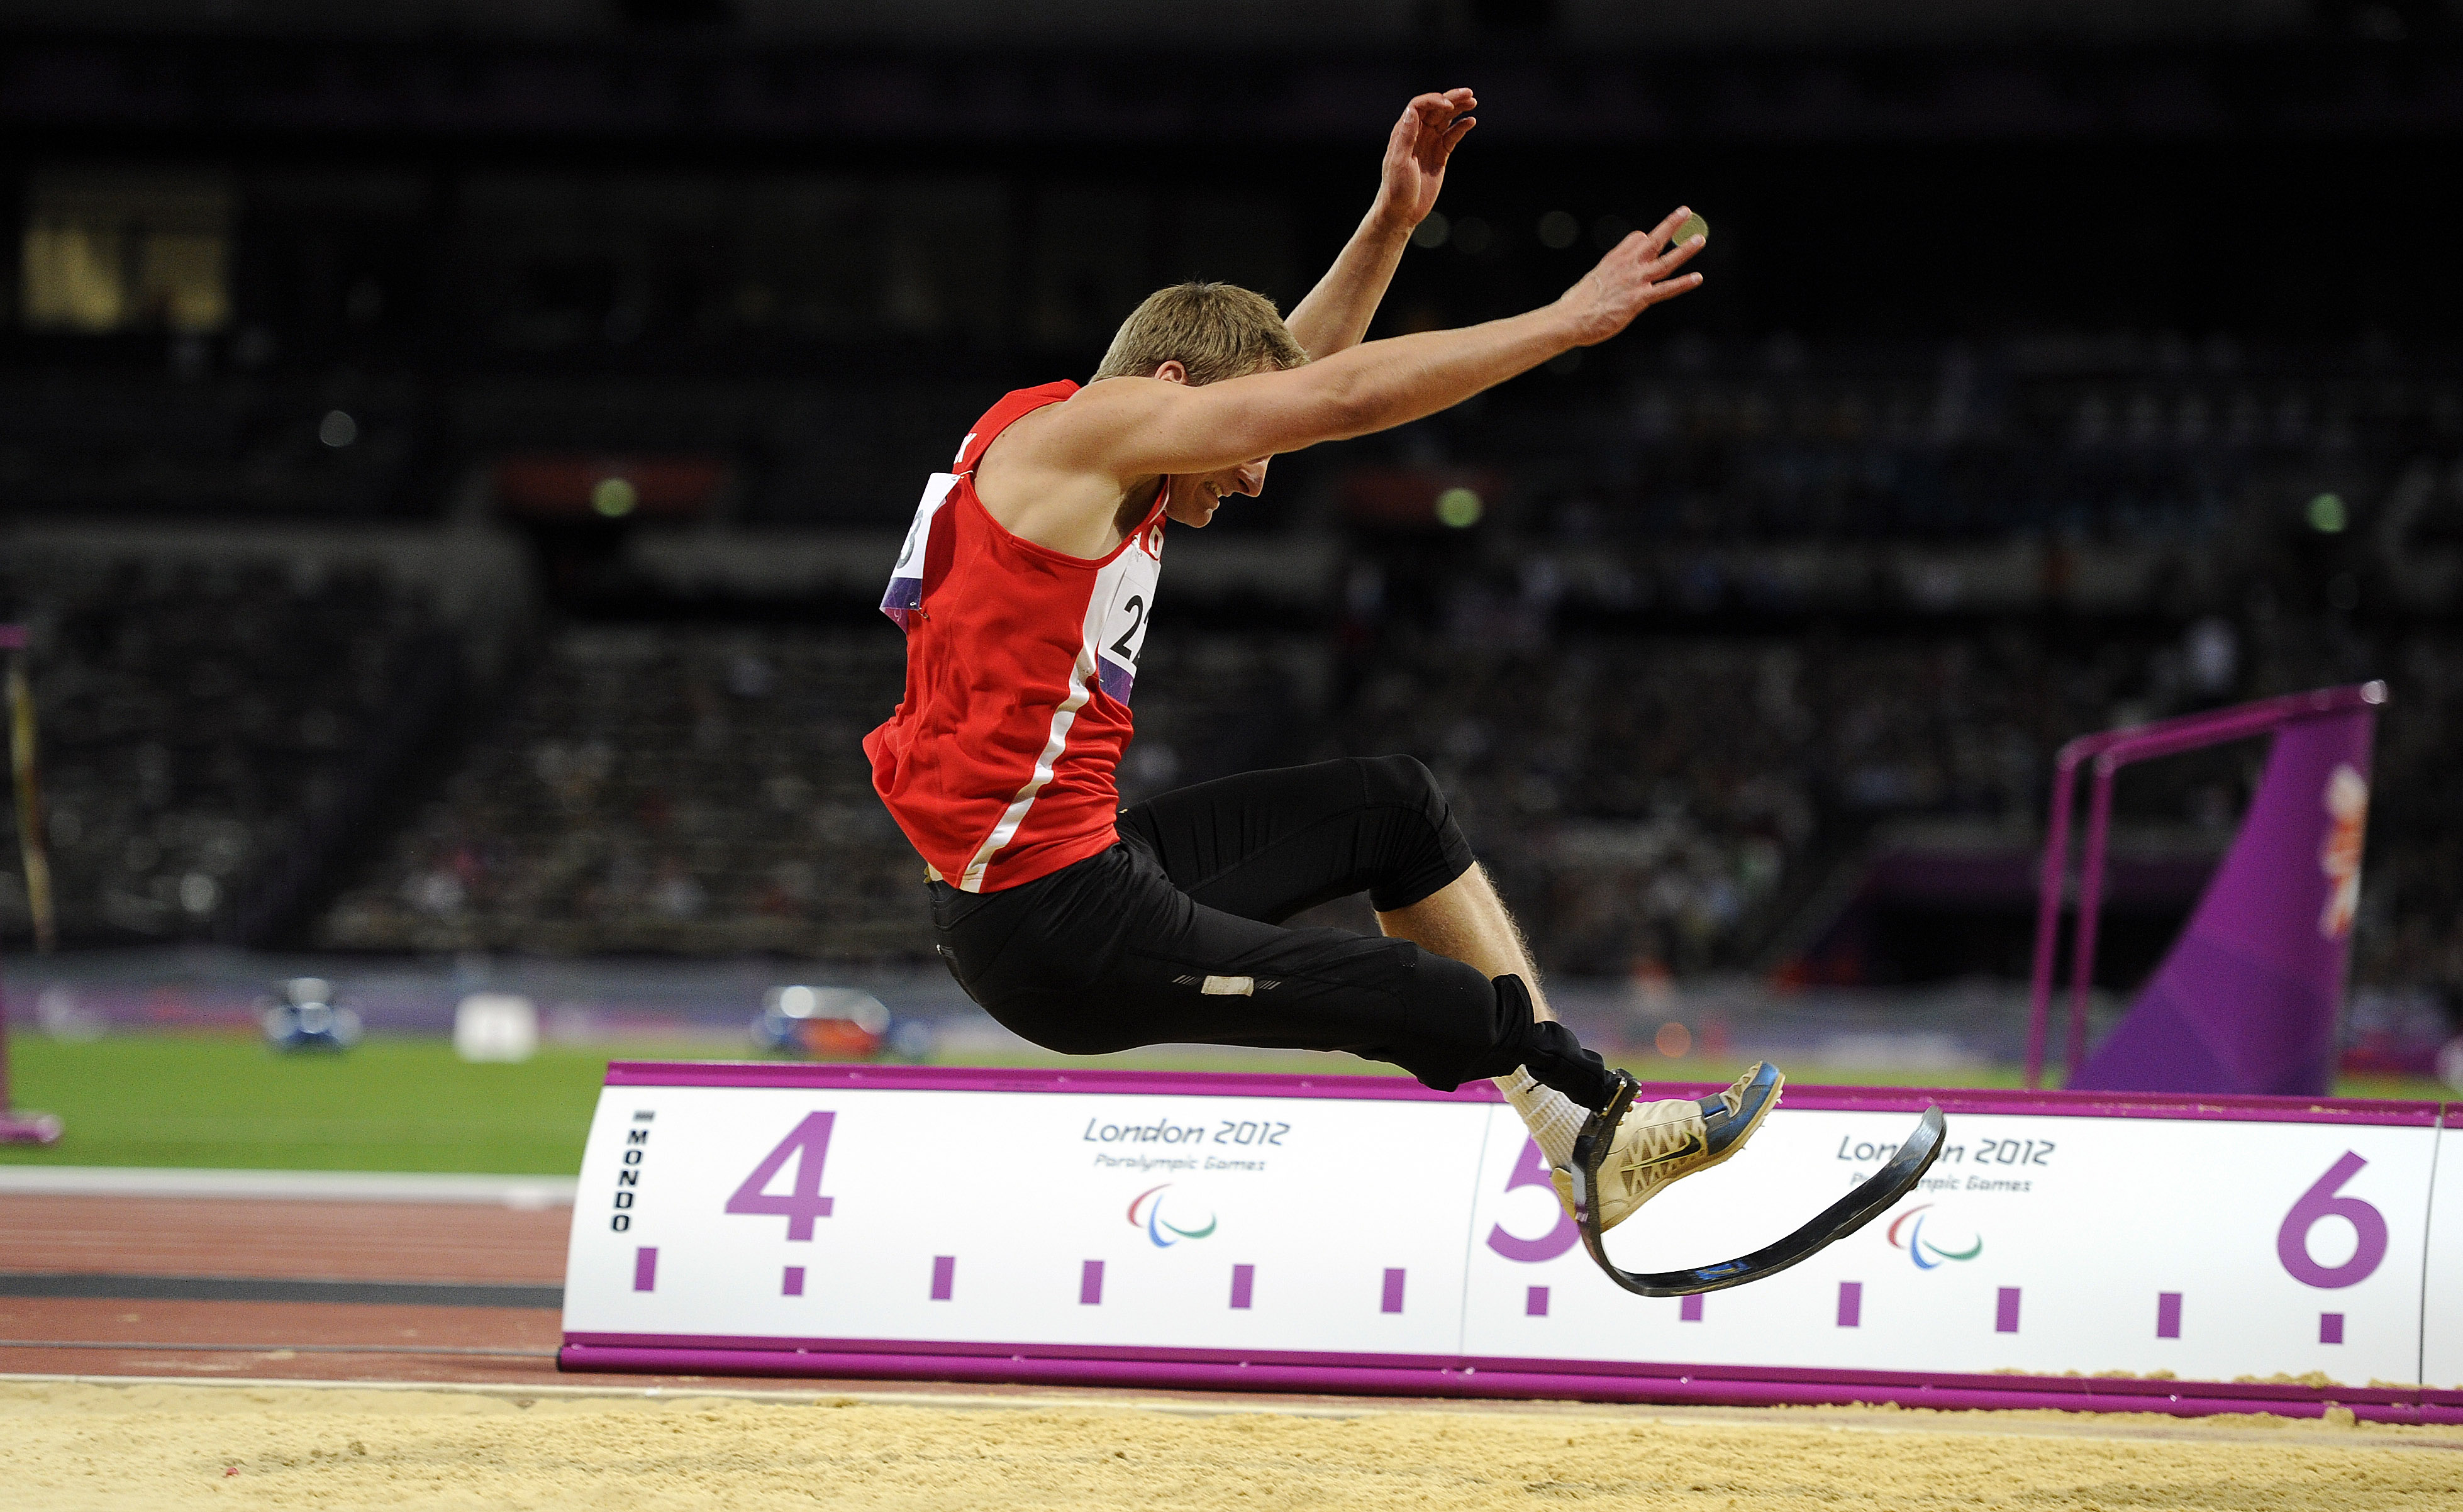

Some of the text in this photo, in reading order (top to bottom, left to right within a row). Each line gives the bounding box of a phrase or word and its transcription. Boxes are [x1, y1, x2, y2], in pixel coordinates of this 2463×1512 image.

[1109, 595, 1150, 660] 2
[1083, 1118, 1290, 1145] London 2012
[1095, 1153, 1265, 1171] Paralympic Games
[1837, 1135, 2055, 1165] Lonn 2012
[611, 1129, 648, 1232] MONDO
[724, 1111, 837, 1242] 4
[1486, 1132, 1581, 1262] 5
[1966, 1175, 2032, 1192] Games
[2276, 1150, 2388, 1289] 6
